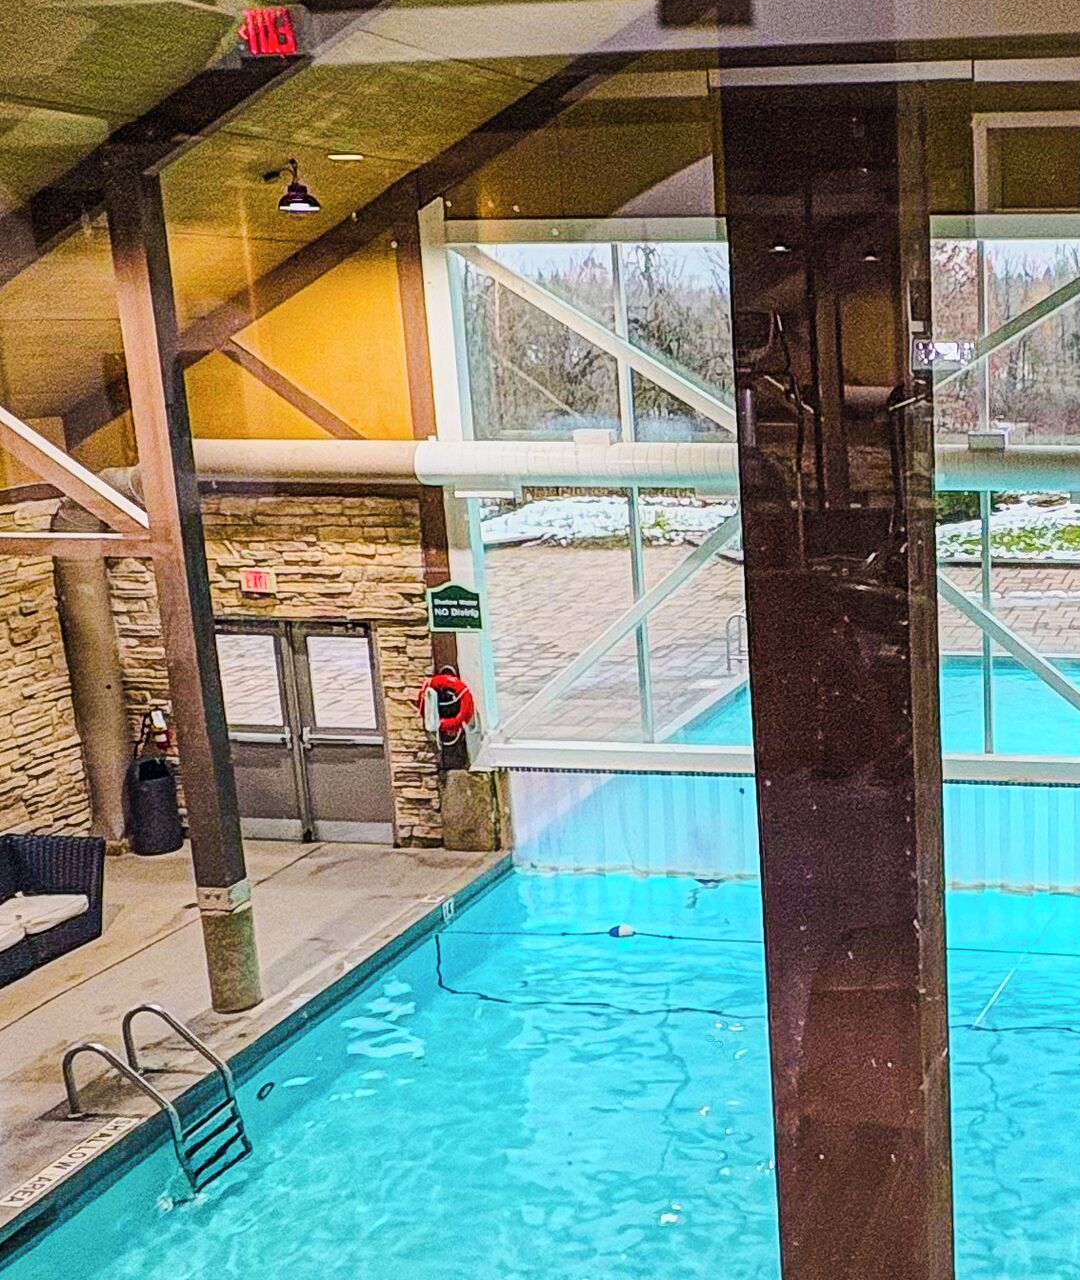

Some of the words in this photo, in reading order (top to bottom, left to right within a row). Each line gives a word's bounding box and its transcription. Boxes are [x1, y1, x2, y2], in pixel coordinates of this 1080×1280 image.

[434, 607, 450, 616] NO
[52, 1119, 132, 1171] SHALLOW
[9, 1176, 53, 1202] AREA
